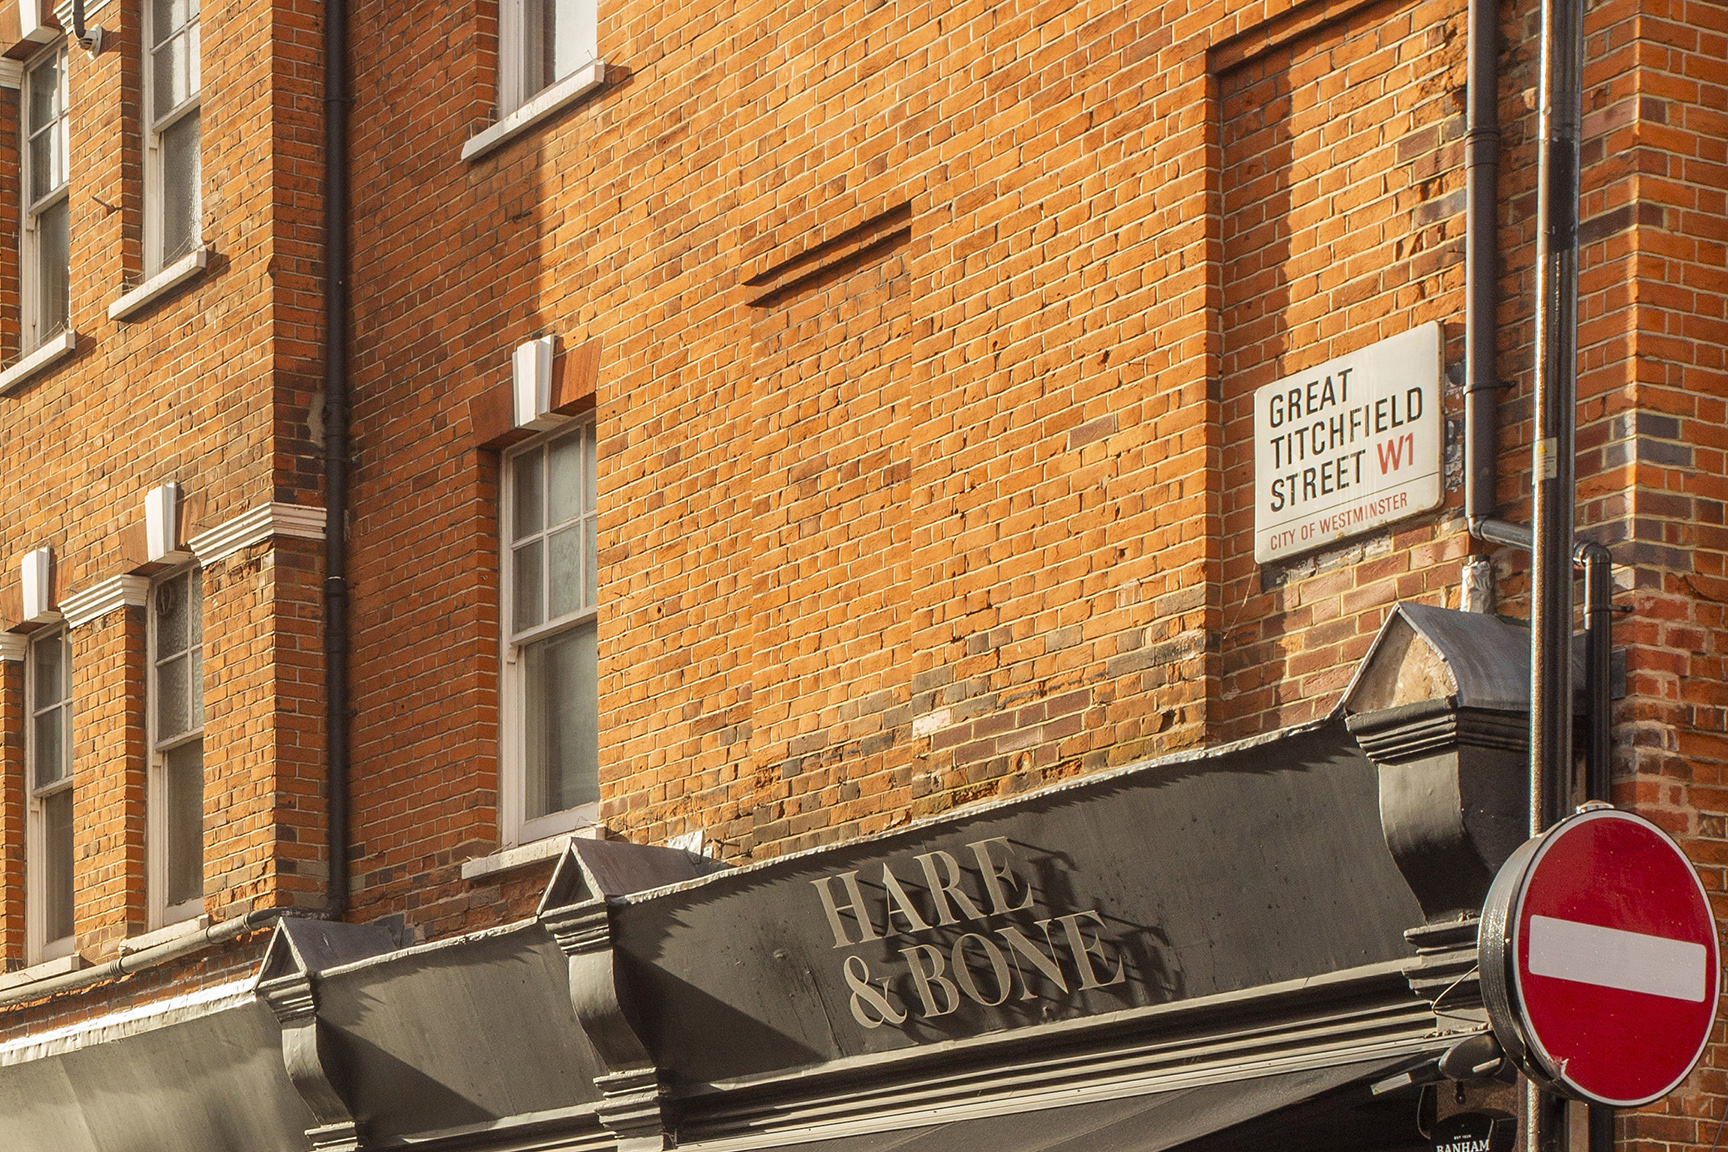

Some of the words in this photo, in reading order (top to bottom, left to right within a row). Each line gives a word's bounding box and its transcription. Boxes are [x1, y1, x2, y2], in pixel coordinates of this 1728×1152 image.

[1269, 367, 1353, 429] GREAT
[1270, 386, 1423, 470] TITCHFIELD
[1270, 449, 1366, 513] STREET
[1377, 432, 1414, 475] W1
[1270, 528, 1296, 551] CITY
[1301, 522, 1316, 541] OF
[1319, 491, 1408, 535] WESTMINSTER
[809, 835, 1034, 949] HARE
